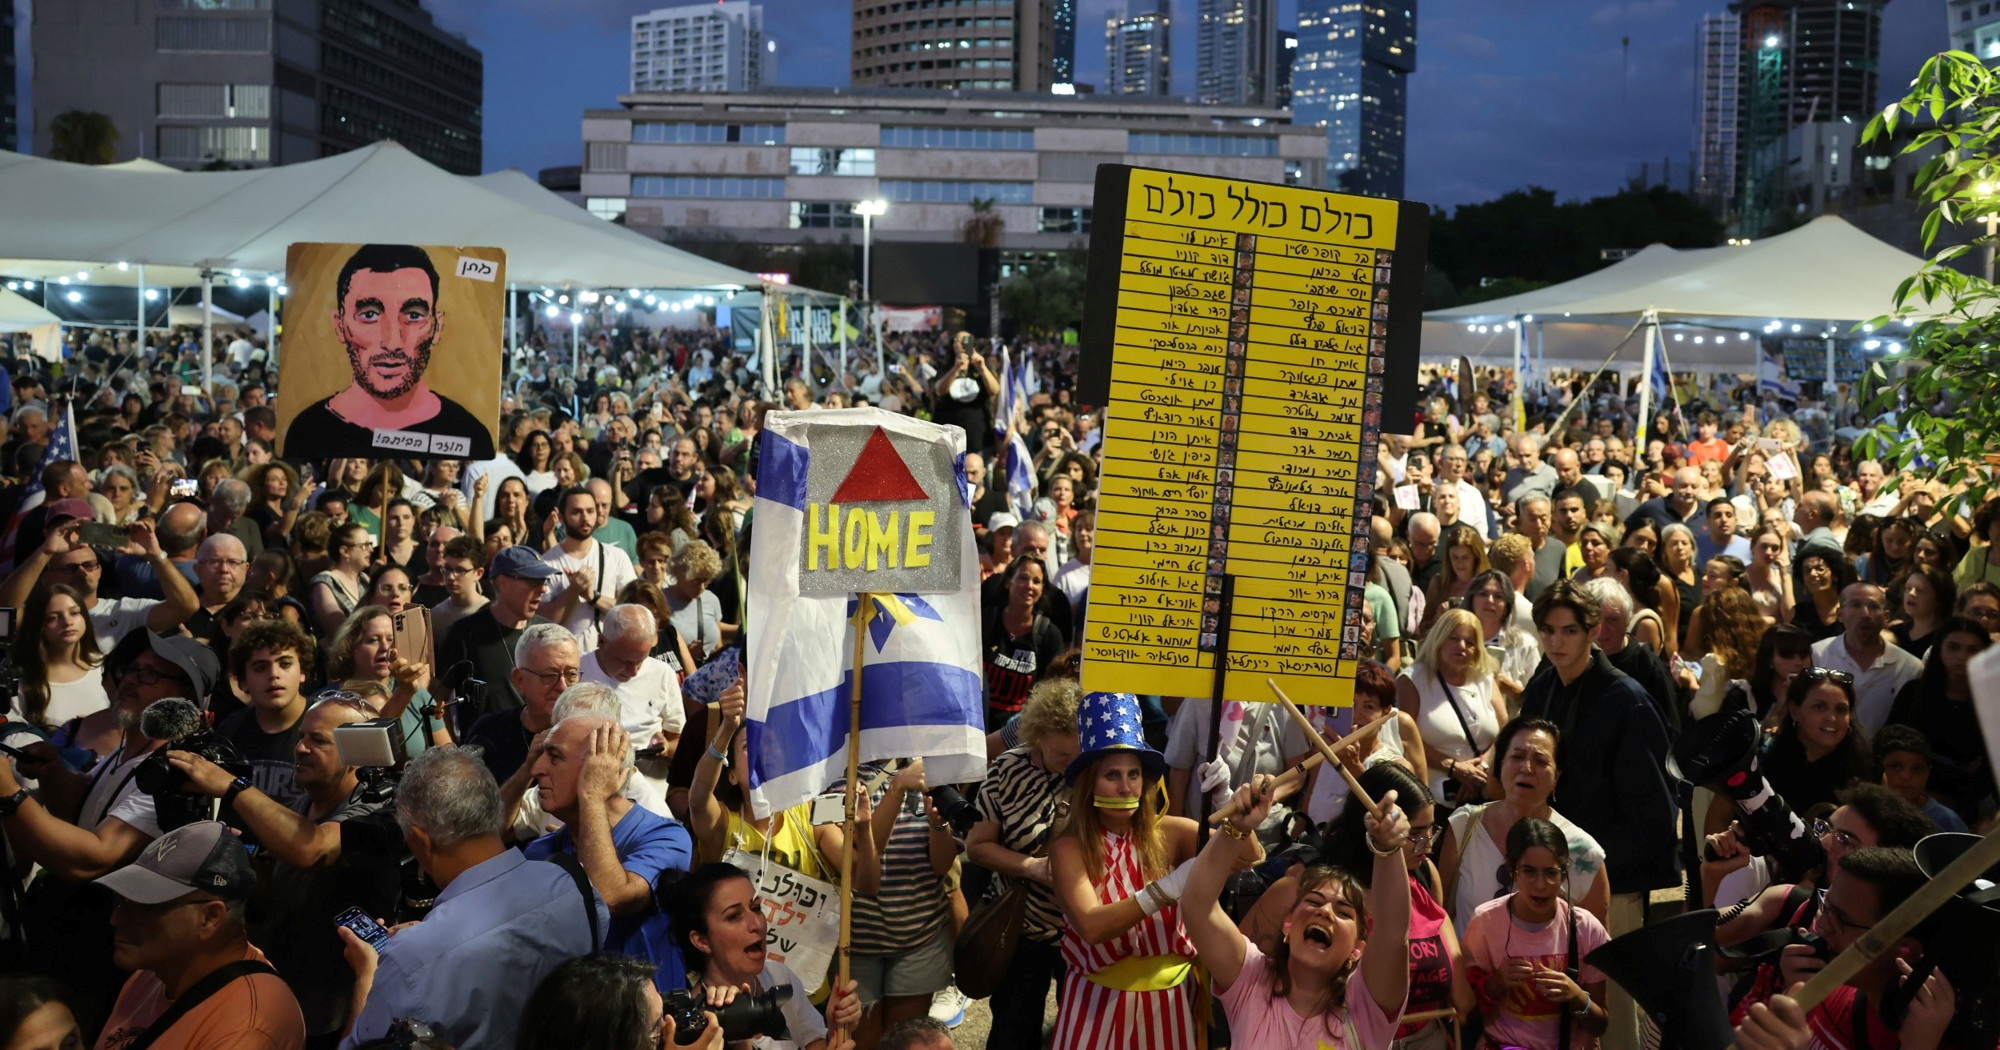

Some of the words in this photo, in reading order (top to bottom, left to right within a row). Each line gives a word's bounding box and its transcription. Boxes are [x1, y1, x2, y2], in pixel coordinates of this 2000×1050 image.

[1143, 176, 1217, 220] כולם
[1228, 185, 1287, 228] כולל
[1300, 197, 1373, 239] כולם
[1203, 234, 1228, 247] איתן
[1176, 250, 1200, 263] קוניו
[1211, 253, 1229, 265] דוד
[1355, 253, 1369, 264] בר
[461, 261, 491, 275] מתן
[1310, 267, 1340, 280] ברמן
[1352, 268, 1367, 283] גלי
[1169, 283, 1199, 301] כלפון
[1203, 290, 1226, 301] שגב
[1306, 284, 1339, 296] שרעבי
[1347, 288, 1366, 299] יוסי
[1290, 299, 1319, 314] קופר
[1327, 305, 1366, 317] עמירם
[1161, 321, 1179, 330] אור
[1187, 323, 1223, 336] אבינתן
[1335, 320, 1365, 335] דניאל
[1203, 345, 1223, 354] רום
[1160, 359, 1186, 371] הימן
[1311, 357, 1325, 367] חן
[1334, 359, 1359, 371] איתי
[1198, 363, 1221, 375] ענבר
[1165, 373, 1194, 385] גוילי
[1333, 378, 1357, 391] מתן
[1204, 380, 1217, 392] רן
[1192, 398, 1215, 410] מתן
[1189, 415, 1215, 427] ליאור
[1331, 413, 1356, 423] עומר
[1152, 430, 1178, 444] הורן
[1289, 427, 1309, 438] דוד
[1319, 431, 1353, 441] אביתר
[376, 433, 423, 448] הביתה!
[436, 441, 463, 453] חוזר
[1187, 434, 1212, 447] איתן
[1292, 445, 1316, 456] אדר
[1326, 449, 1352, 460] תמיר
[1158, 468, 1181, 480] אהל
[1282, 464, 1316, 477] נמרודי
[1326, 469, 1351, 478] תמיר
[1186, 470, 1209, 485] אלון
[1186, 486, 1208, 498] יוסף
[1321, 486, 1349, 497] אריה
[1289, 497, 1321, 514] דניאל
[1155, 506, 1178, 522] ברוך
[1184, 509, 1207, 519] סהר
[1329, 506, 1348, 519] עוז
[808, 503, 935, 571] HOME
[1146, 540, 1167, 554] כהן
[1174, 544, 1202, 555] נמרוד
[1188, 560, 1202, 572] טל
[1291, 555, 1321, 568] ברמן
[1330, 558, 1342, 568] זיו
[1288, 570, 1307, 580] מור
[1316, 571, 1342, 586] איתן
[1178, 576, 1199, 591] גיא
[1289, 588, 1311, 598] אור
[1118, 593, 1147, 607] ברוך
[1158, 594, 1198, 608] אוריאל
[1129, 612, 1154, 626] קוניו
[1162, 614, 1195, 627] אריאל
[1261, 606, 1294, 622] הרקין
[1300, 610, 1336, 626] מקסים
[1273, 625, 1296, 639] מירן
[1304, 628, 1333, 639] עמרי
[1308, 641, 1333, 655] אסף
[755, 897, 807, 926] ילד
[766, 928, 797, 953] של
[1410, 940, 1439, 959] ORY
